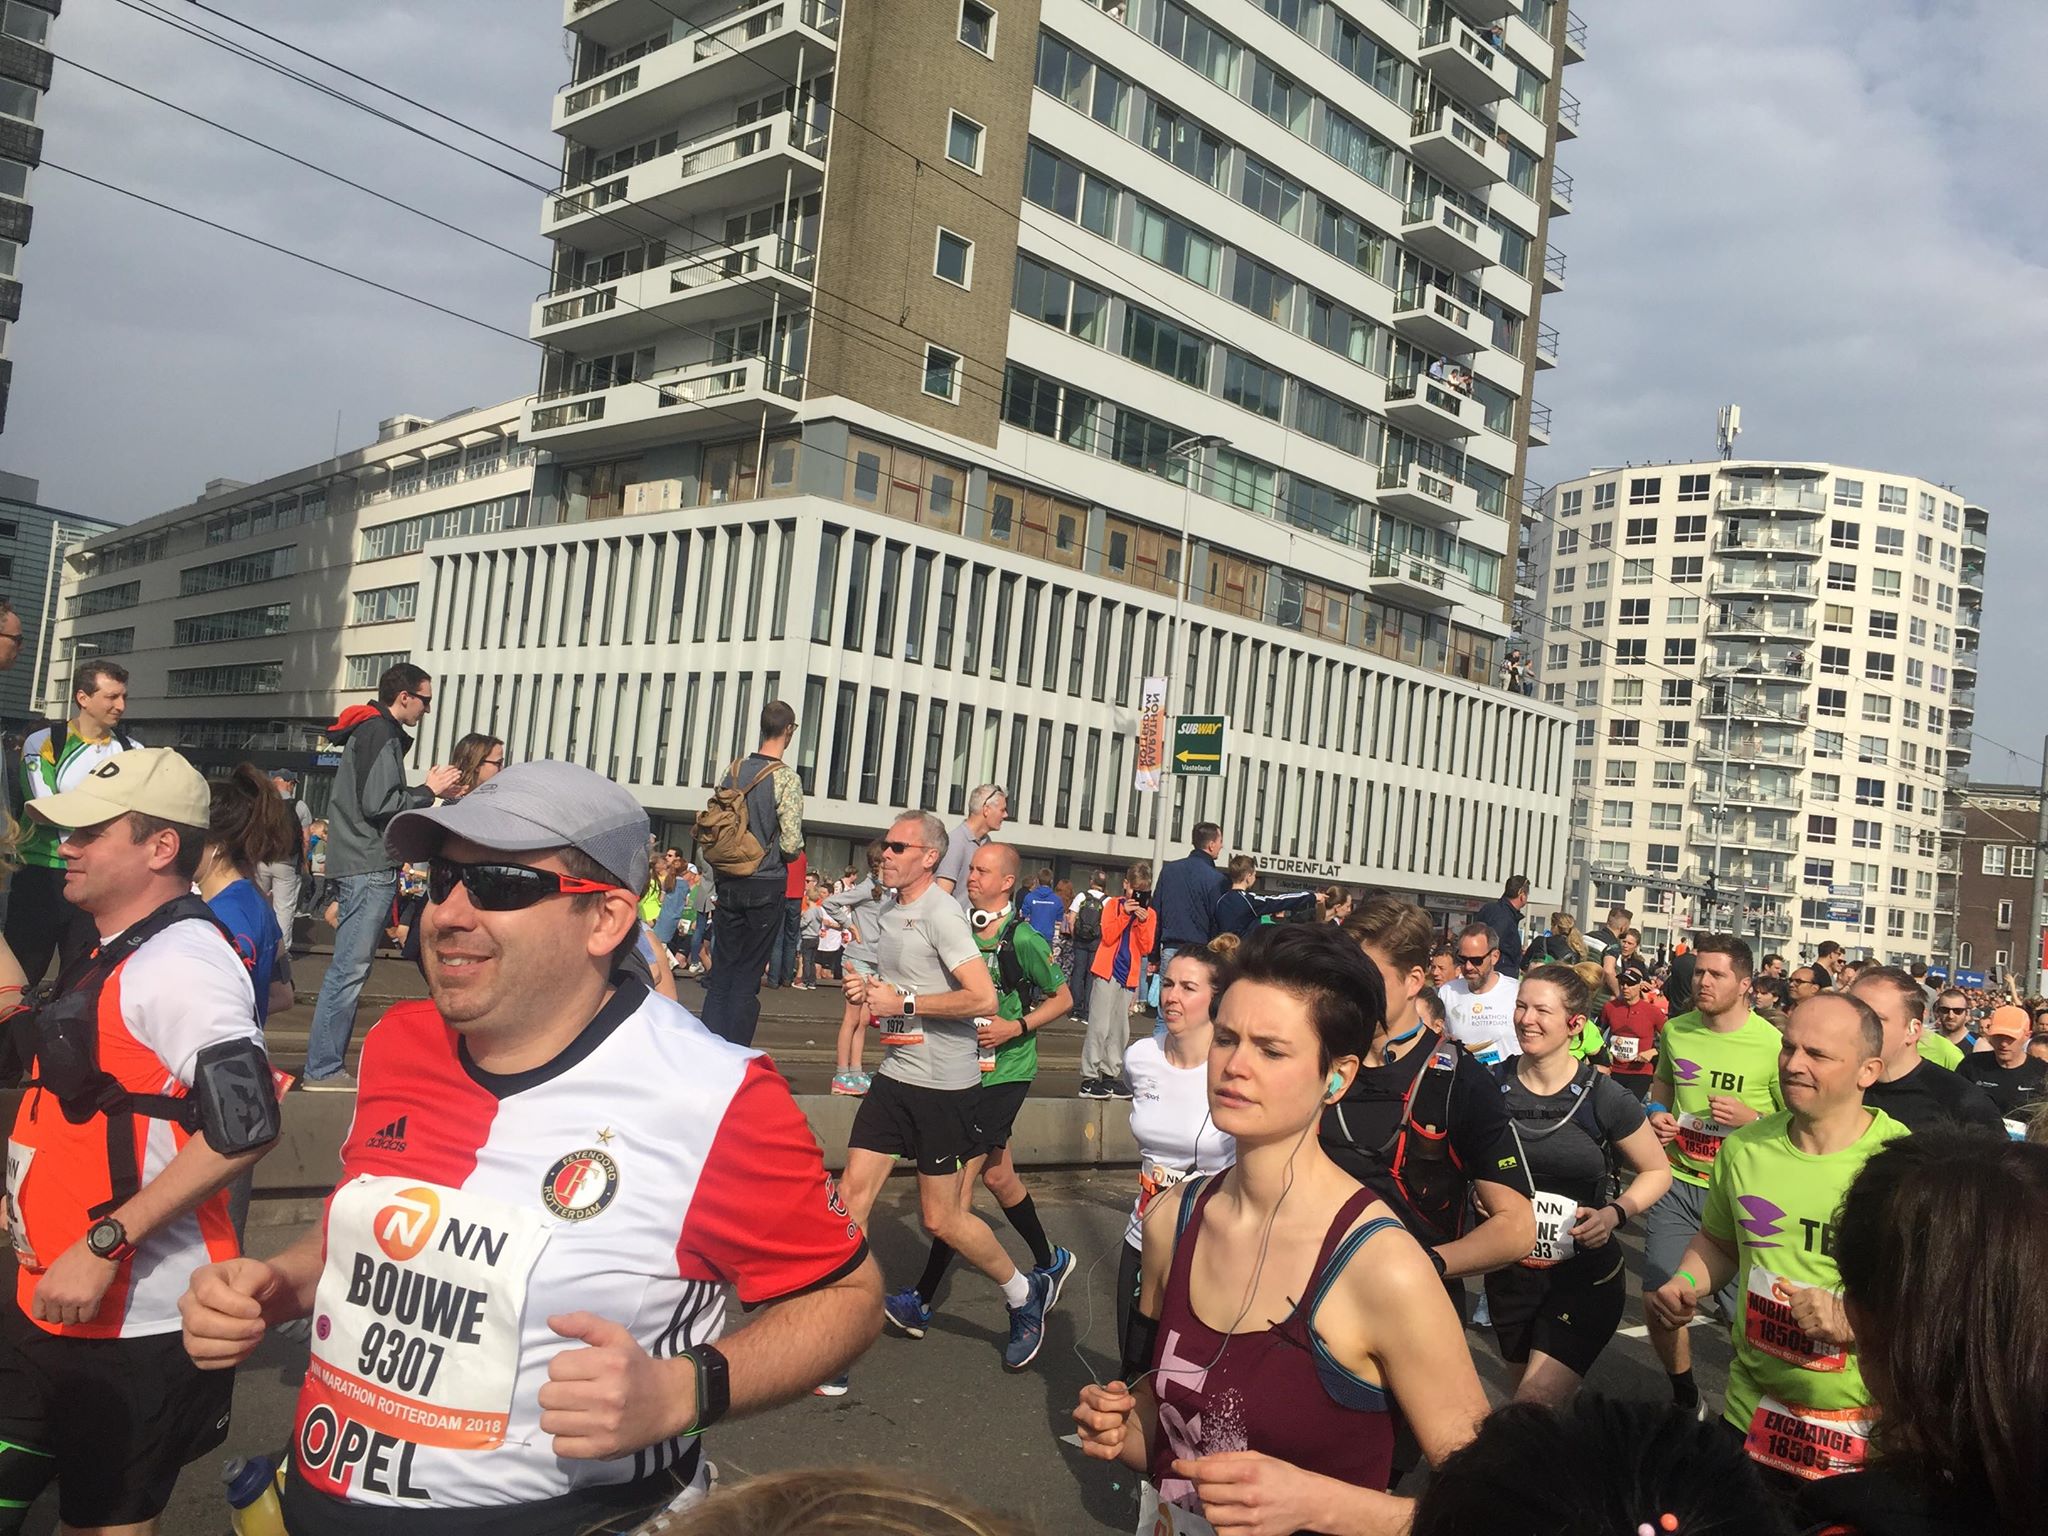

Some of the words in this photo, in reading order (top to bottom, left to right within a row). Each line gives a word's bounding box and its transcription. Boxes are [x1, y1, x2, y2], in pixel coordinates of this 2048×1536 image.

[1177, 722, 1222, 735] SUBWAY
[887, 1019, 905, 1034] 1972
[1710, 1070, 1744, 1093] TBI
[1705, 1123, 1720, 1132] NN
[366, 1137, 407, 1153] adidas
[1685, 1140, 1717, 1157] 18503
[562, 1150, 617, 1182] FEYENOORD
[543, 1185, 602, 1219] ROTTERDAM
[1537, 1200, 1563, 1216] NN
[438, 1217, 509, 1267] NN
[1537, 1221, 1559, 1242] NE
[1799, 1217, 1841, 1256] TB
[1531, 1241, 1552, 1258] 93
[345, 1251, 488, 1345] BOUWE
[1760, 1318, 1811, 1355] 18505
[357, 1321, 446, 1397] 9307
[321, 1369, 376, 1408] MARATHON
[377, 1396, 462, 1431] ROTTERDAM
[464, 1417, 502, 1434] 2018
[1764, 1410, 1853, 1454] EXCHANGE
[301, 1403, 433, 1501] OPEL
[1760, 1453, 1795, 1472] MARATHON
[1768, 1434, 1831, 1472] 18505
